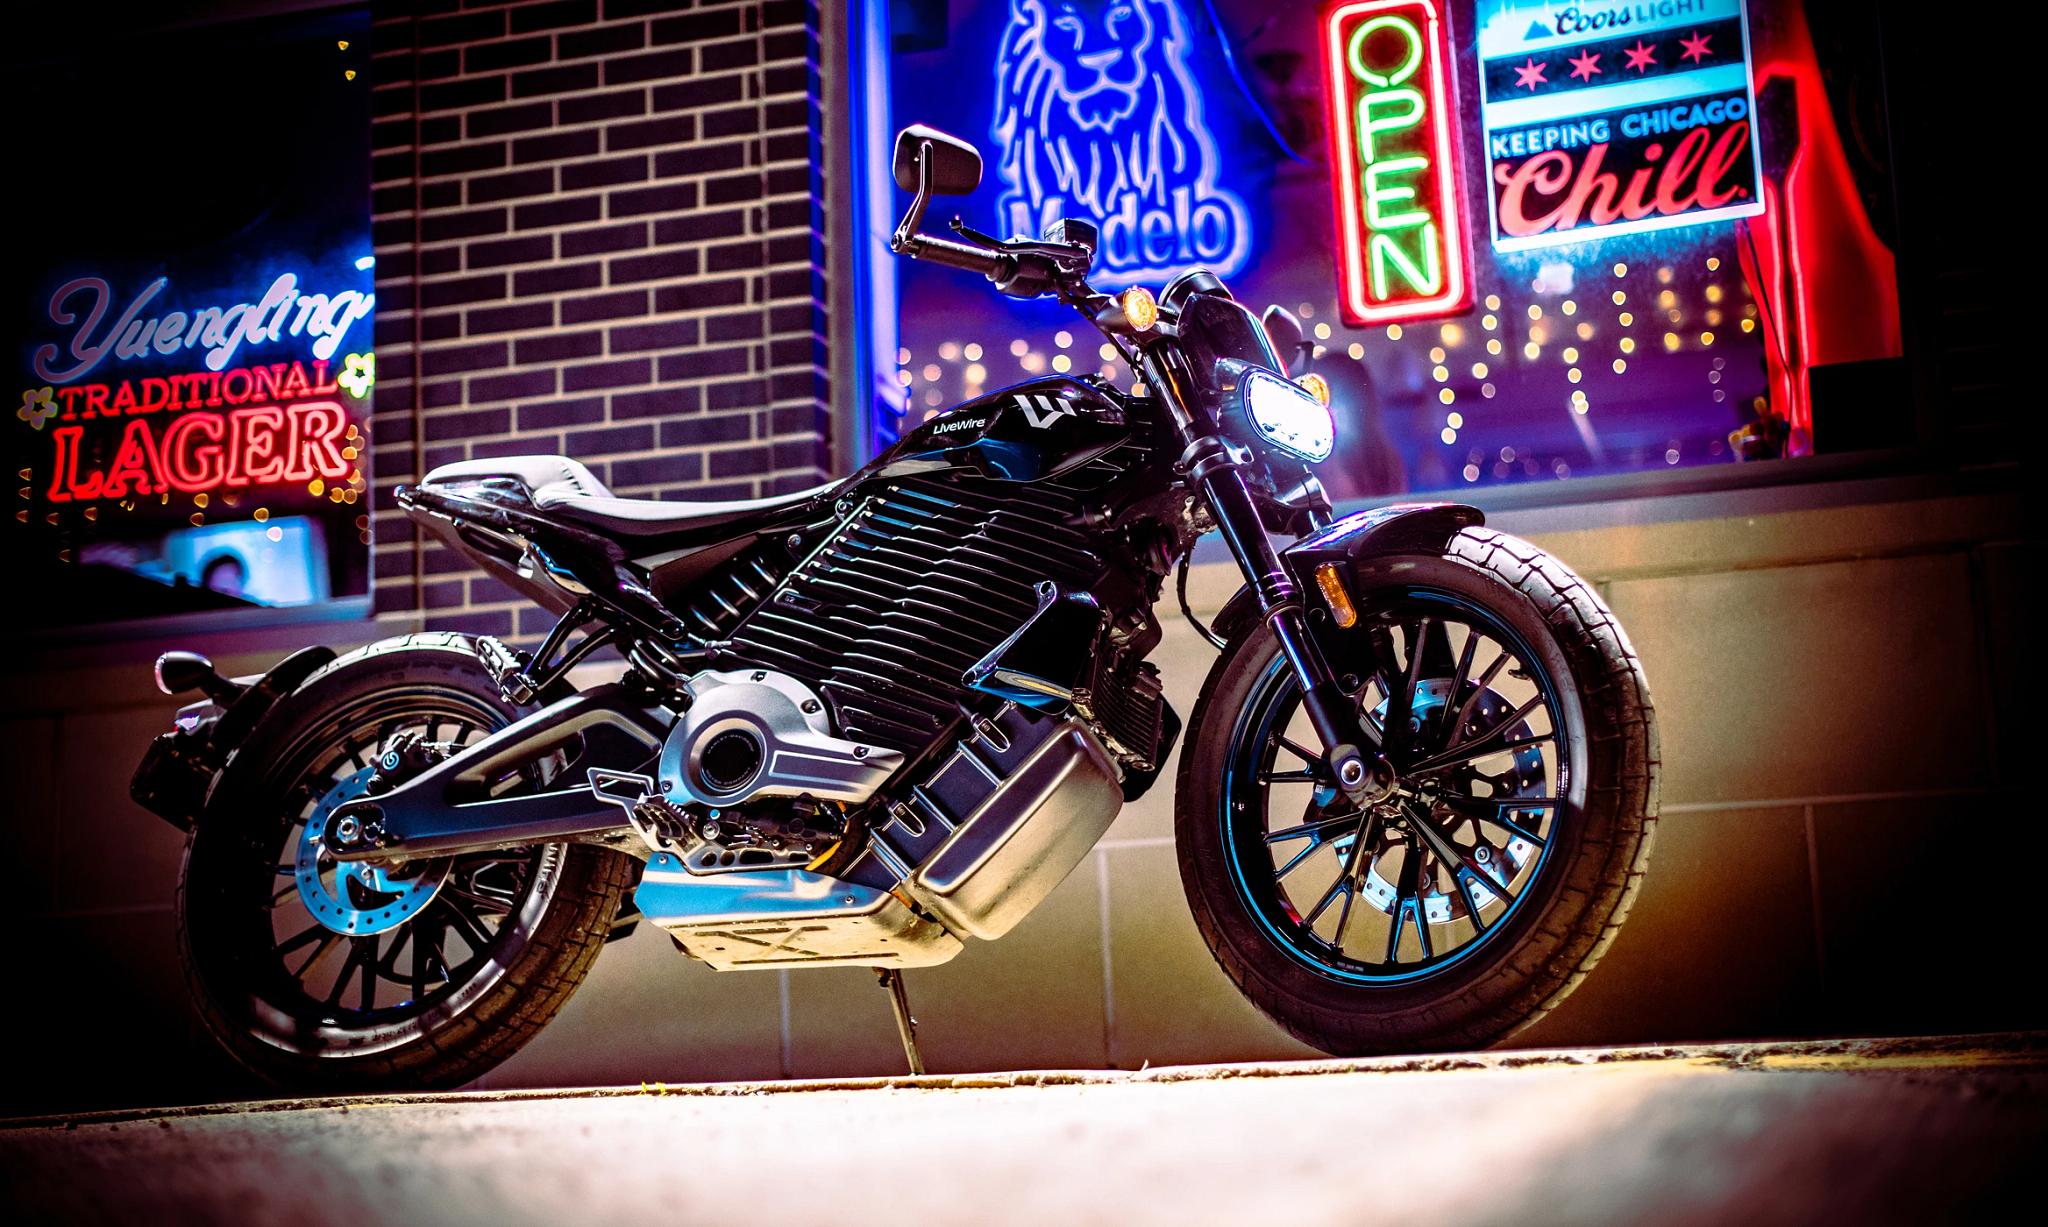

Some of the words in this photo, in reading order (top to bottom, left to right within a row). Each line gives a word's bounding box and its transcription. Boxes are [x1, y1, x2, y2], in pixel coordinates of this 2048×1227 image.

[1555, 7, 1631, 35] Coors
[1493, 119, 1610, 158] KEEPING
[1620, 98, 1747, 137] CHICAGO
[1349, 16, 1439, 301] OPEN
[34, 273, 374, 383] Yuengling
[57, 361, 339, 420] TRADITIONAL
[47, 402, 349, 502] LAGER
[933, 418, 985, 434] LiveWire
